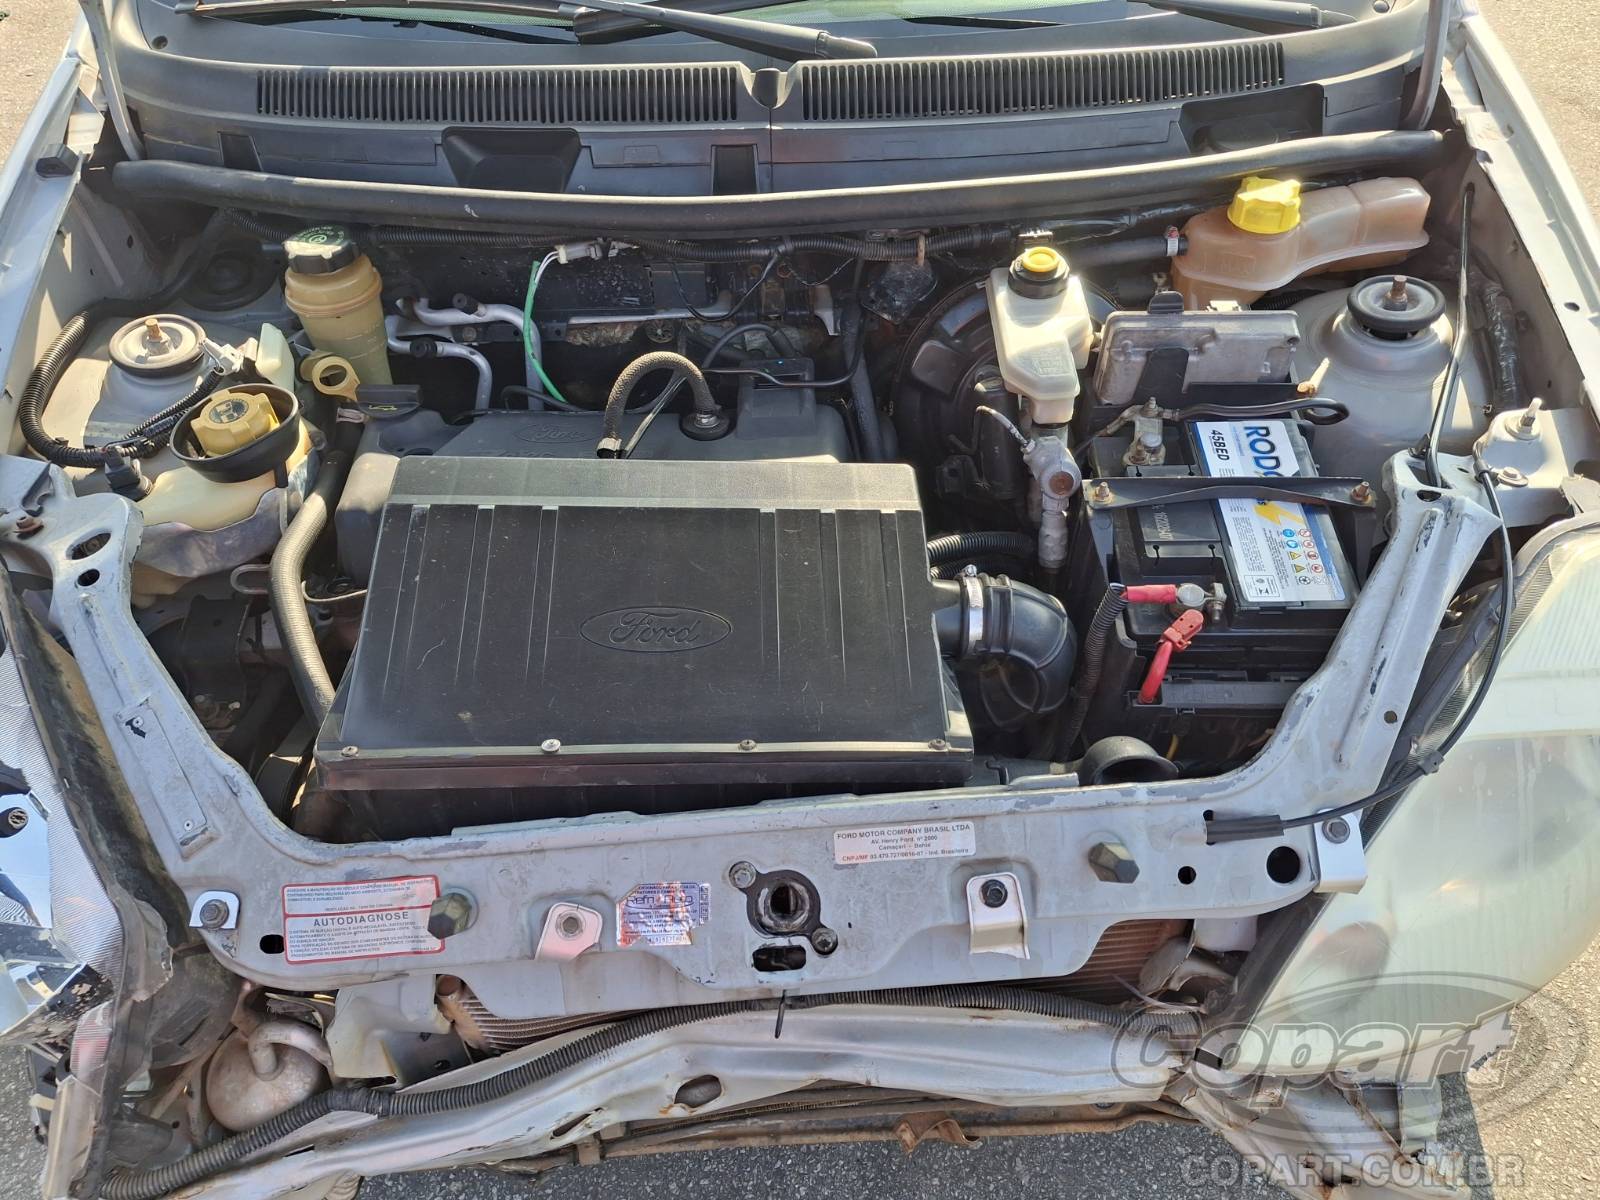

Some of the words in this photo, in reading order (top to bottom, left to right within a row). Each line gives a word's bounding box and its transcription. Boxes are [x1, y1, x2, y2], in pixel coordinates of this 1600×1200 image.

[1210, 429, 1231, 461] 45BED
[608, 611, 701, 645] Ford
[858, 830, 885, 838] MOTOR
[886, 827, 922, 836] COMPANY
[924, 826, 950, 834] BRASIL
[314, 912, 408, 927] AUTODIAGNOSE
